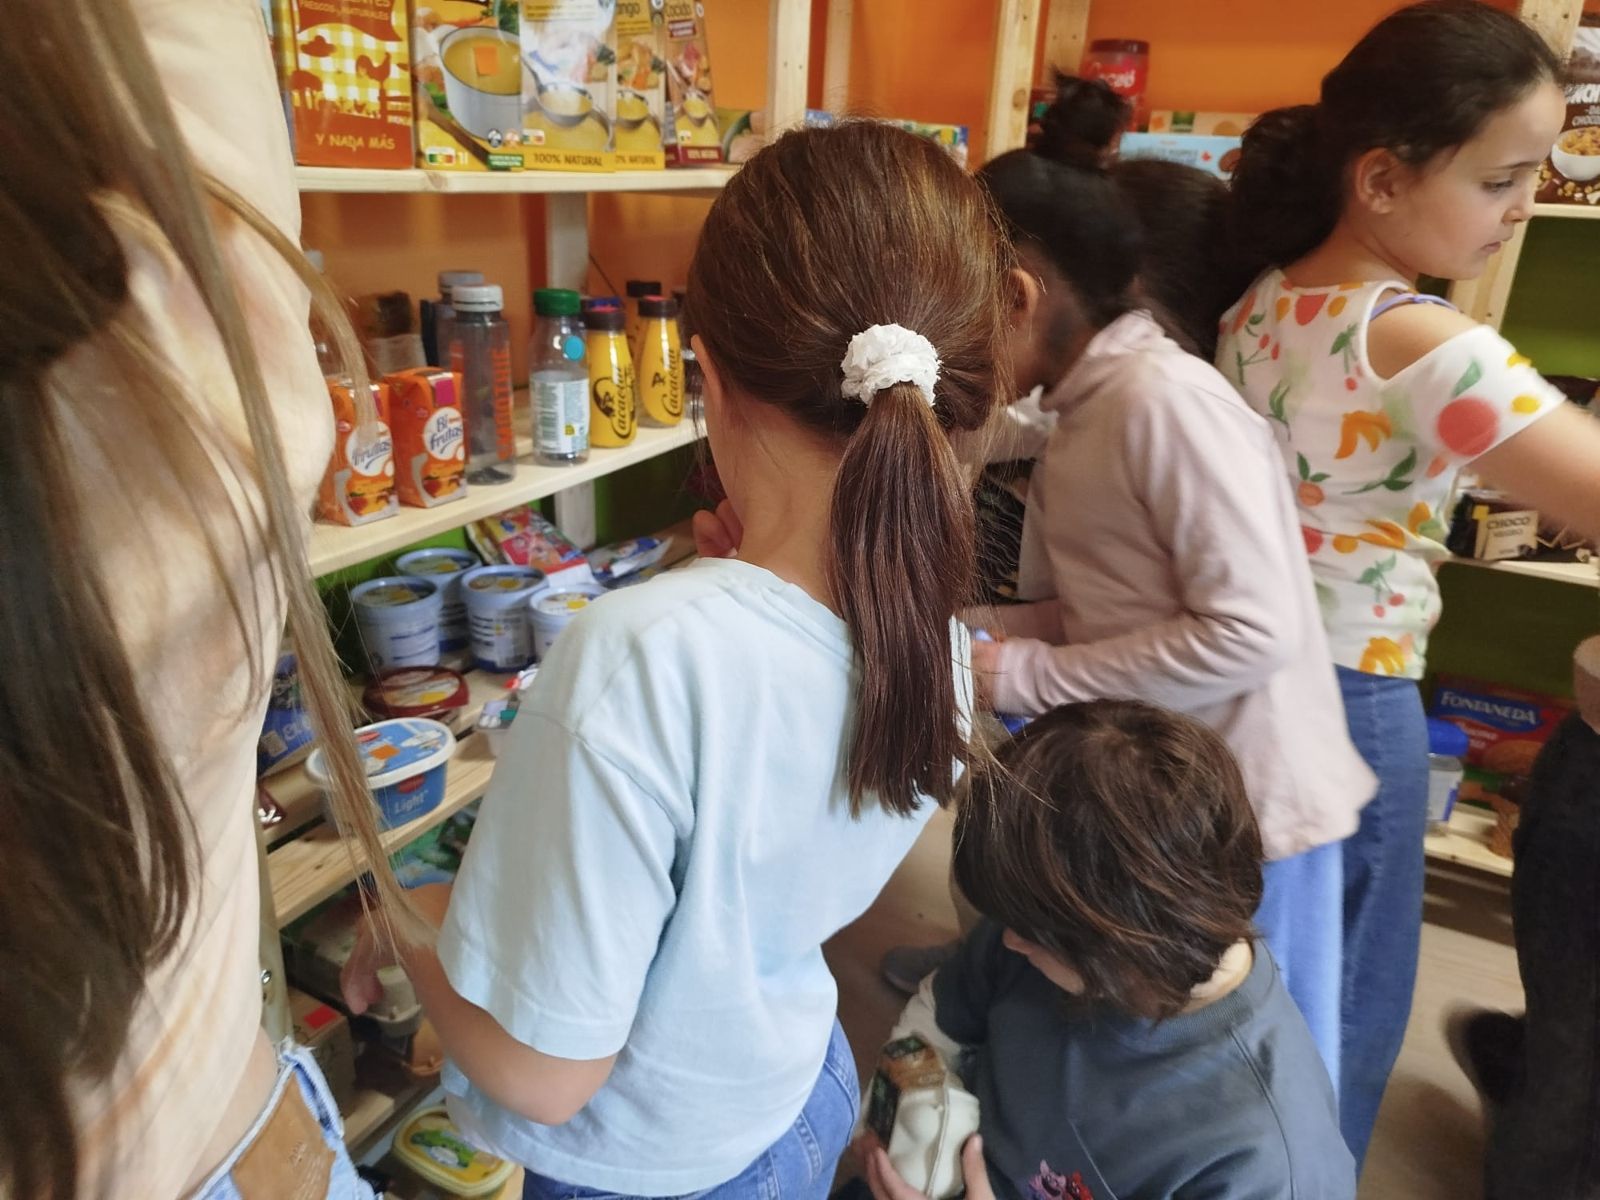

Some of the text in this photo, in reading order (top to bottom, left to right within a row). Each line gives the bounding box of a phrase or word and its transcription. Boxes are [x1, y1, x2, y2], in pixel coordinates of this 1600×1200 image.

[315, 133, 396, 152] Y NADA MÁS
[534, 153, 560, 164] 100%
[565, 155, 603, 167] NATURAL
[429, 426, 462, 452] frutas
[1441, 690, 1537, 726] FONTANEDA
[394, 792, 425, 814] Light
